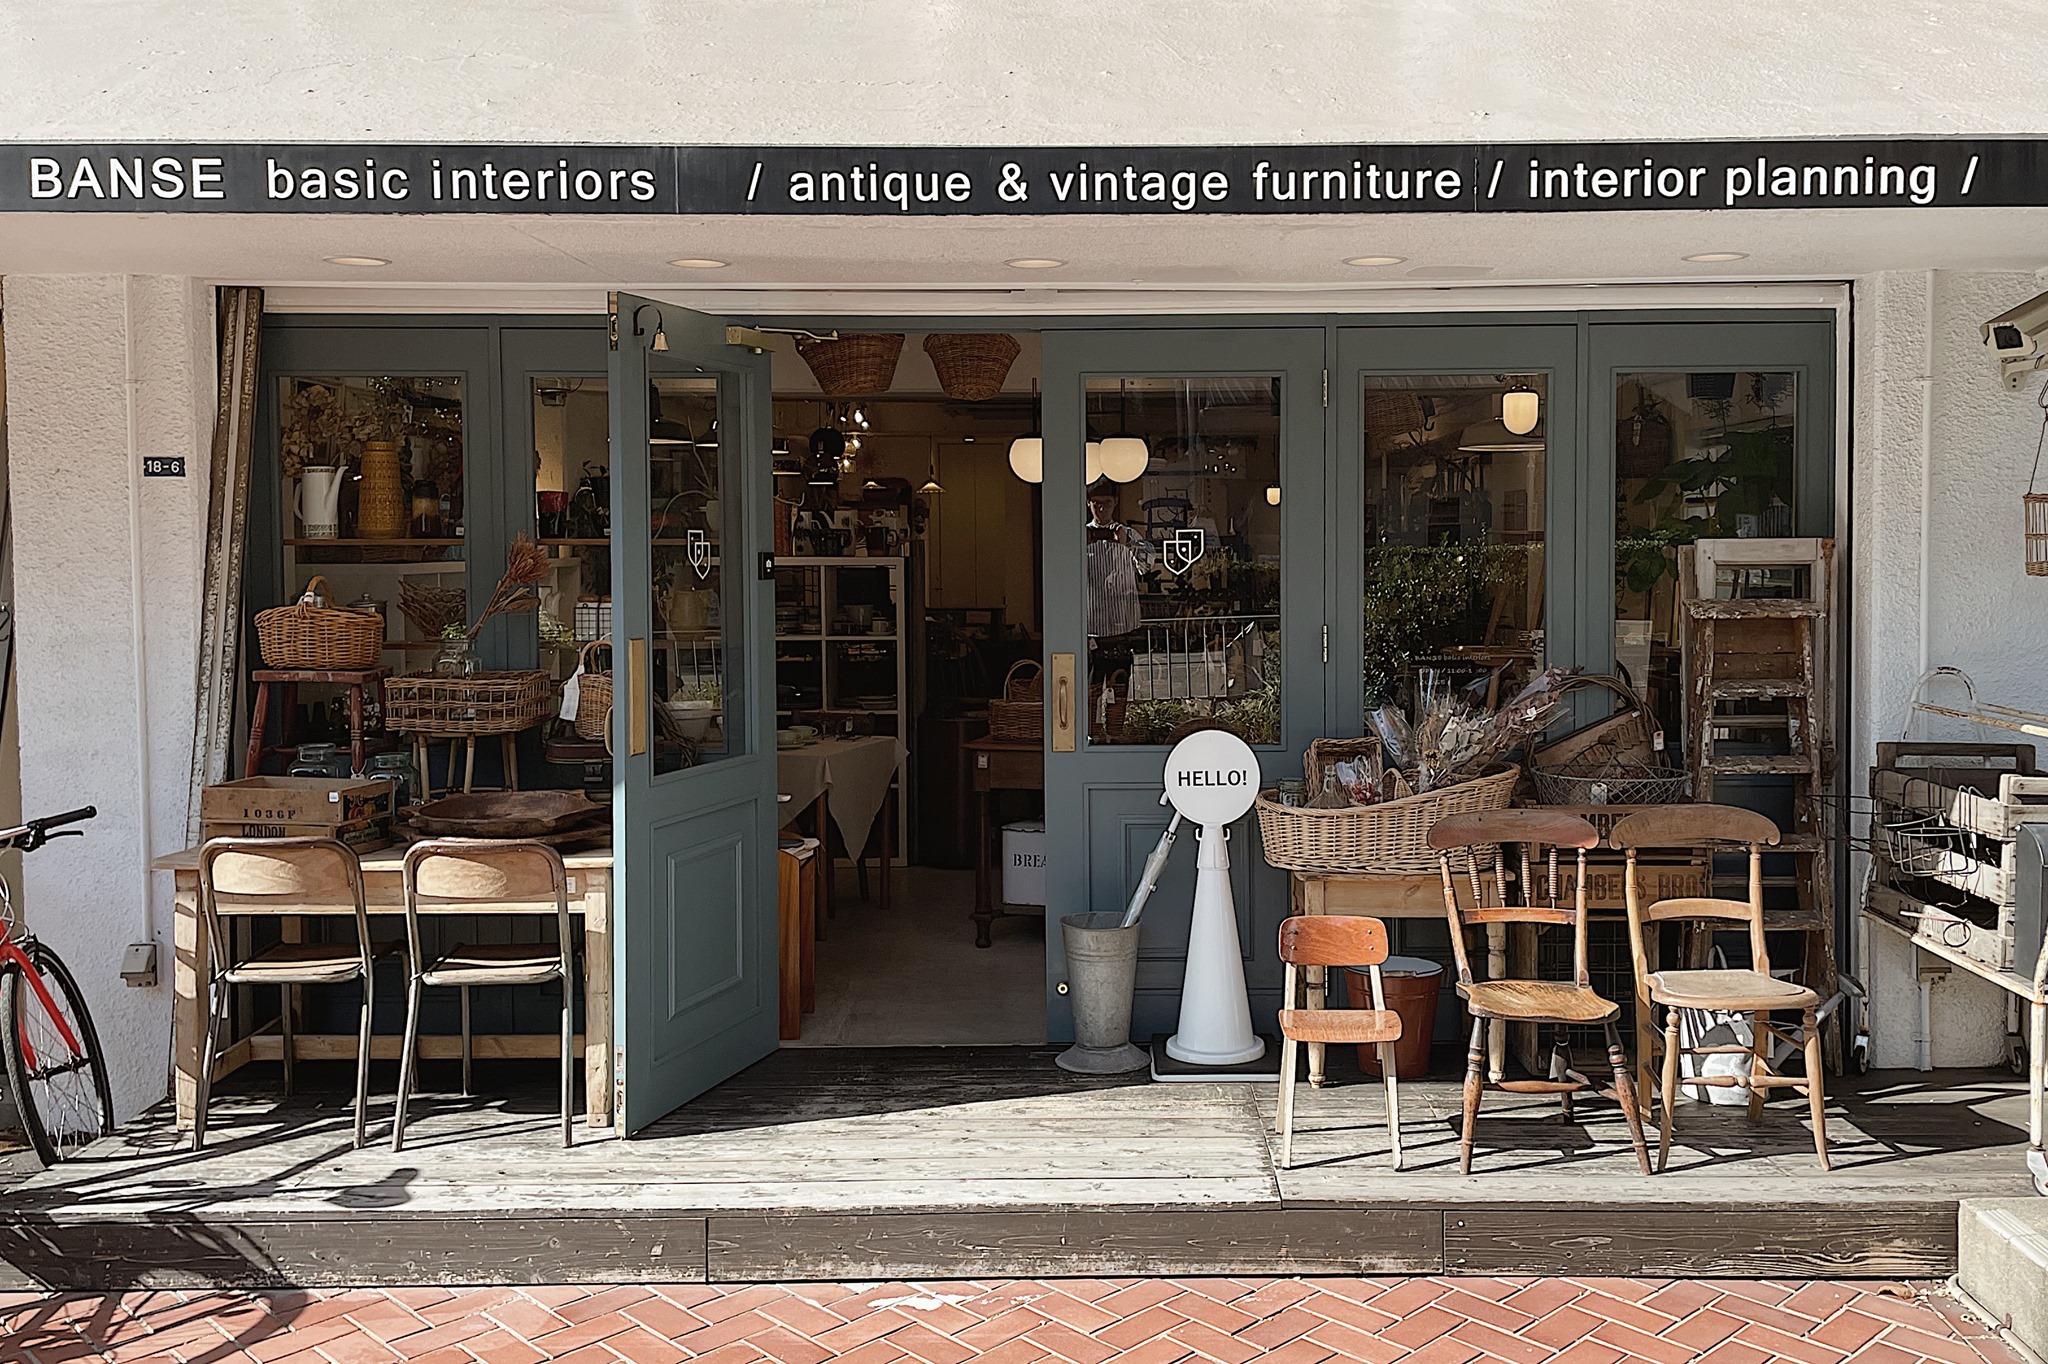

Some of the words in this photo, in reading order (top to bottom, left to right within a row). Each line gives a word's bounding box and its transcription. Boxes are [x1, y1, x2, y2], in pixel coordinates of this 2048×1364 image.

[30, 157, 224, 199] BANSE
[267, 158, 408, 200] basic
[432, 159, 655, 201] interiors
[747, 162, 762, 201] /
[789, 163, 971, 211] antique
[998, 162, 1028, 202] &
[1049, 163, 1228, 211] vintage
[1252, 161, 1461, 201] furniture
[1487, 160, 1504, 199] /
[1530, 159, 1706, 198] interior
[1726, 156, 1936, 206] planning
[1961, 156, 1979, 195] /
[146, 460, 180, 473] 18-6
[1178, 770, 1247, 787] HELLO!
[241, 824, 286, 838] LONDON
